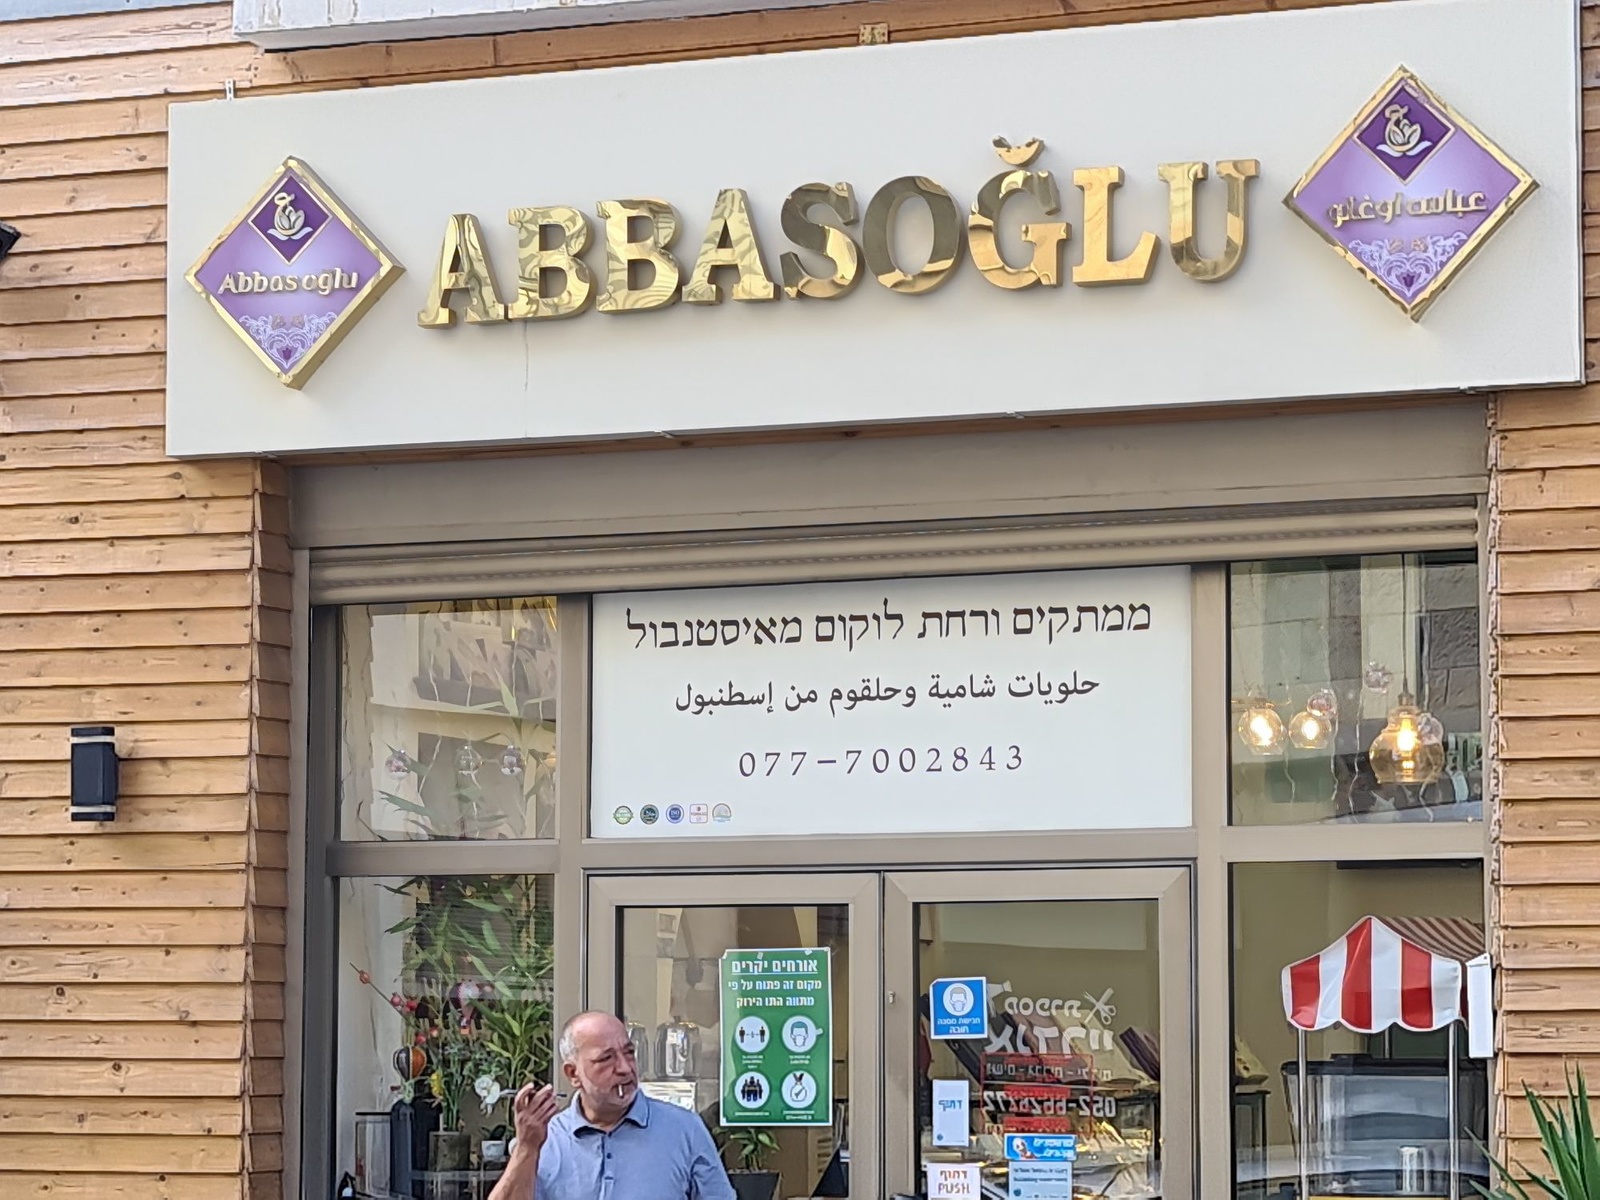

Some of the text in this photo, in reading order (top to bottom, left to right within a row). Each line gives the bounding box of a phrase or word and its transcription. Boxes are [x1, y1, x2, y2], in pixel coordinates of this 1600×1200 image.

[417, 135, 1260, 329] ABBASOĞLU
[626, 597, 1151, 652] ממתקים ורחת לוקום מאיסטנבול
[676, 670, 1100, 718] حلويات شامية وحلقوم من إسطنبول
[739, 745, 1022, 777] 077-7002843
[731, 960, 817, 974] אורחים יקרים
[728, 979, 822, 991] מקום זה פתוח על פי
[736, 996, 814, 1008] מתווה התו הירוק
[949, 1026, 969, 1034] חובה
[938, 1182, 970, 1194] PUSH
